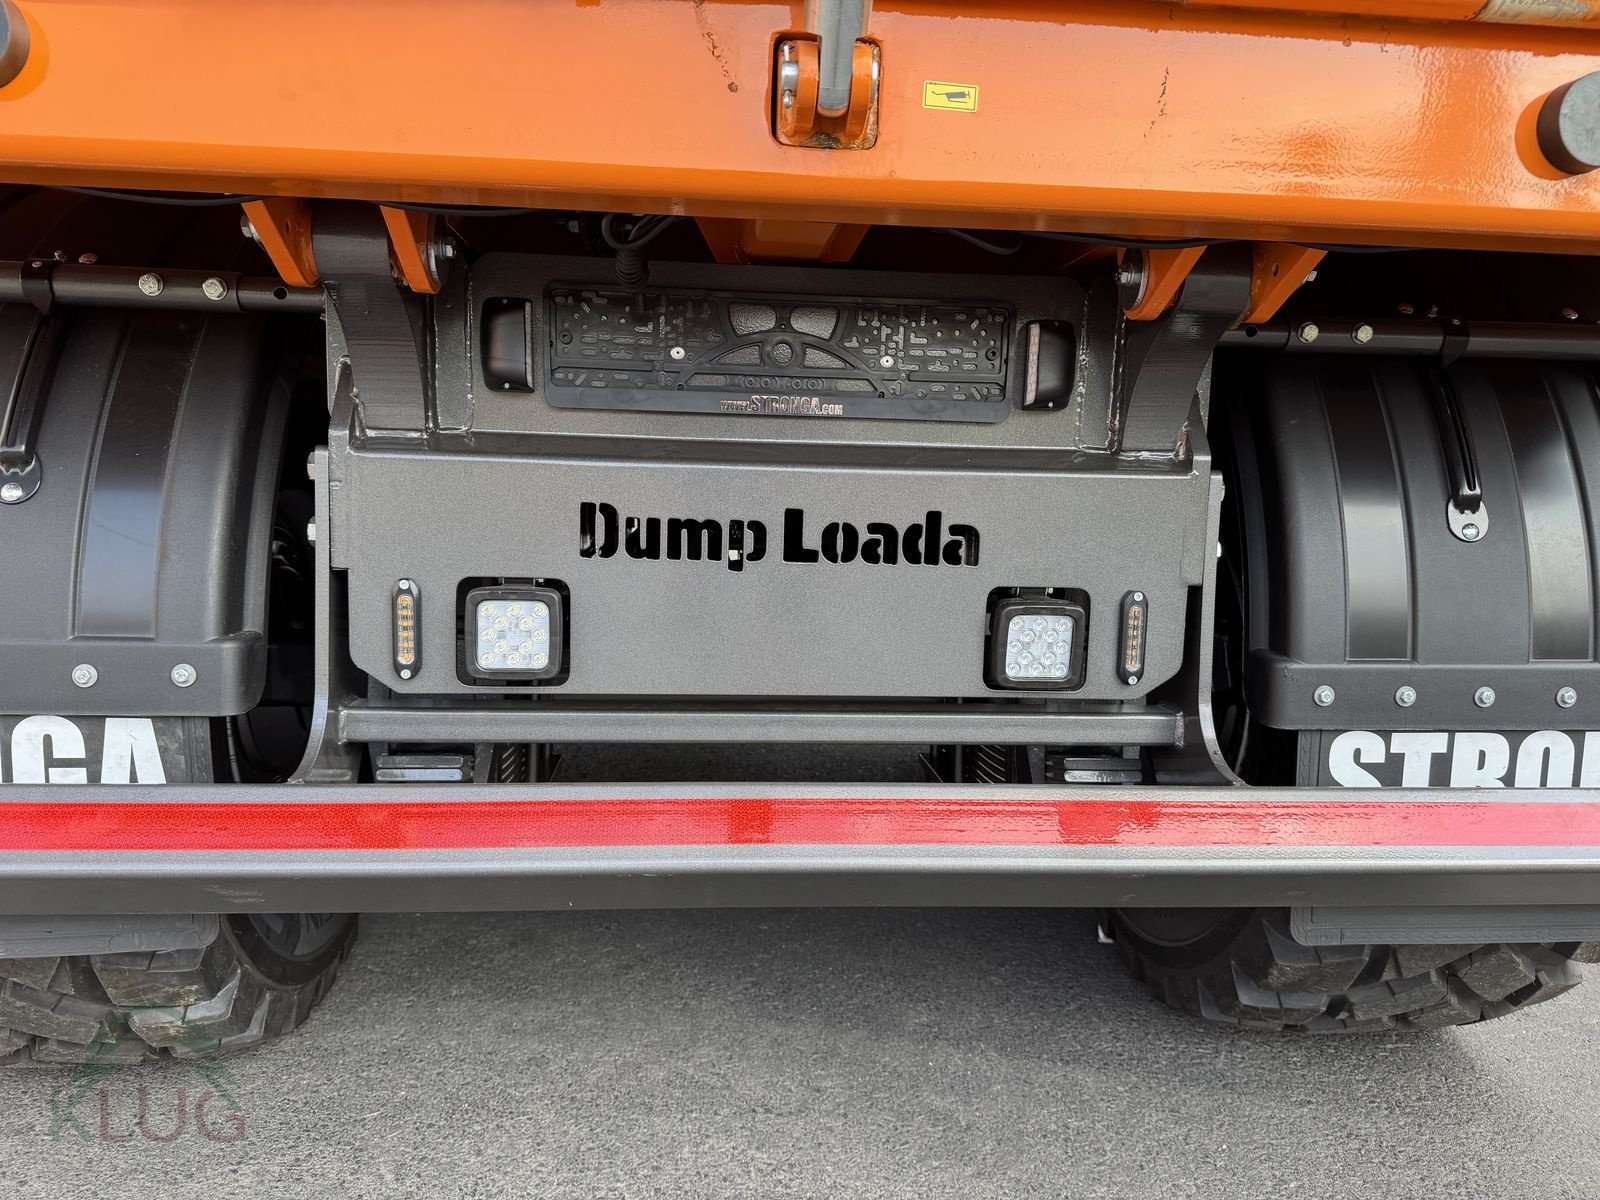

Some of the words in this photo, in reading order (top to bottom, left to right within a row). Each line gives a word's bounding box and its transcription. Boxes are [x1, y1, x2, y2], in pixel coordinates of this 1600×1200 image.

[579, 502, 767, 572] Dump
[783, 508, 981, 567] Loada
[0, 715, 167, 784] GA
